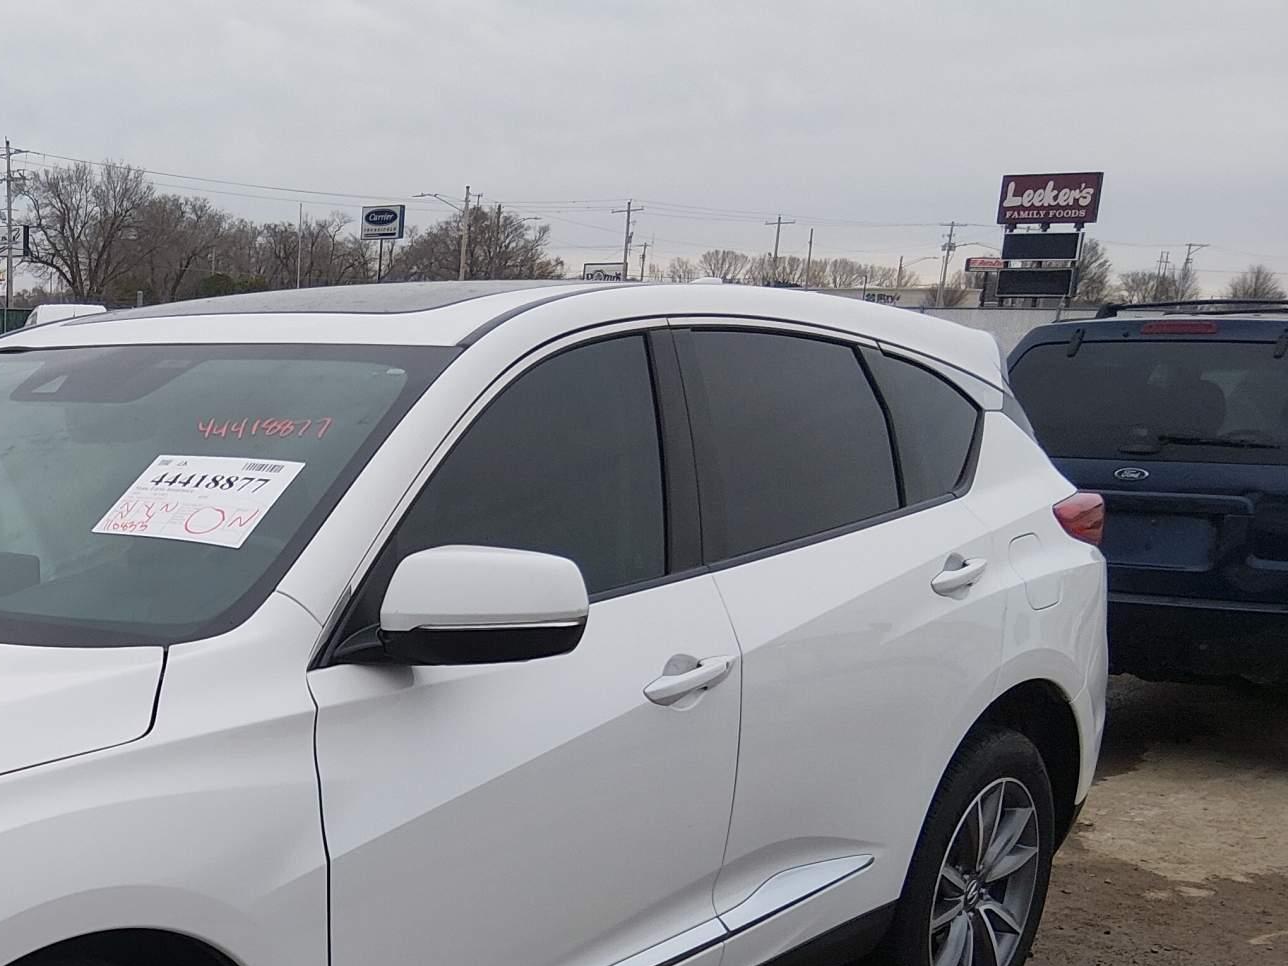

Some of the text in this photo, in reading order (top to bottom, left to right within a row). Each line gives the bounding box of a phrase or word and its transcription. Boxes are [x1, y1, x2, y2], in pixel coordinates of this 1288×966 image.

[1003, 181, 1094, 207] Leeker's
[369, 211, 394, 222] Carrier
[1005, 208, 1086, 219] FAMILY FOODS
[197, 417, 333, 439] 44418877
[150, 471, 271, 493] 44418877
